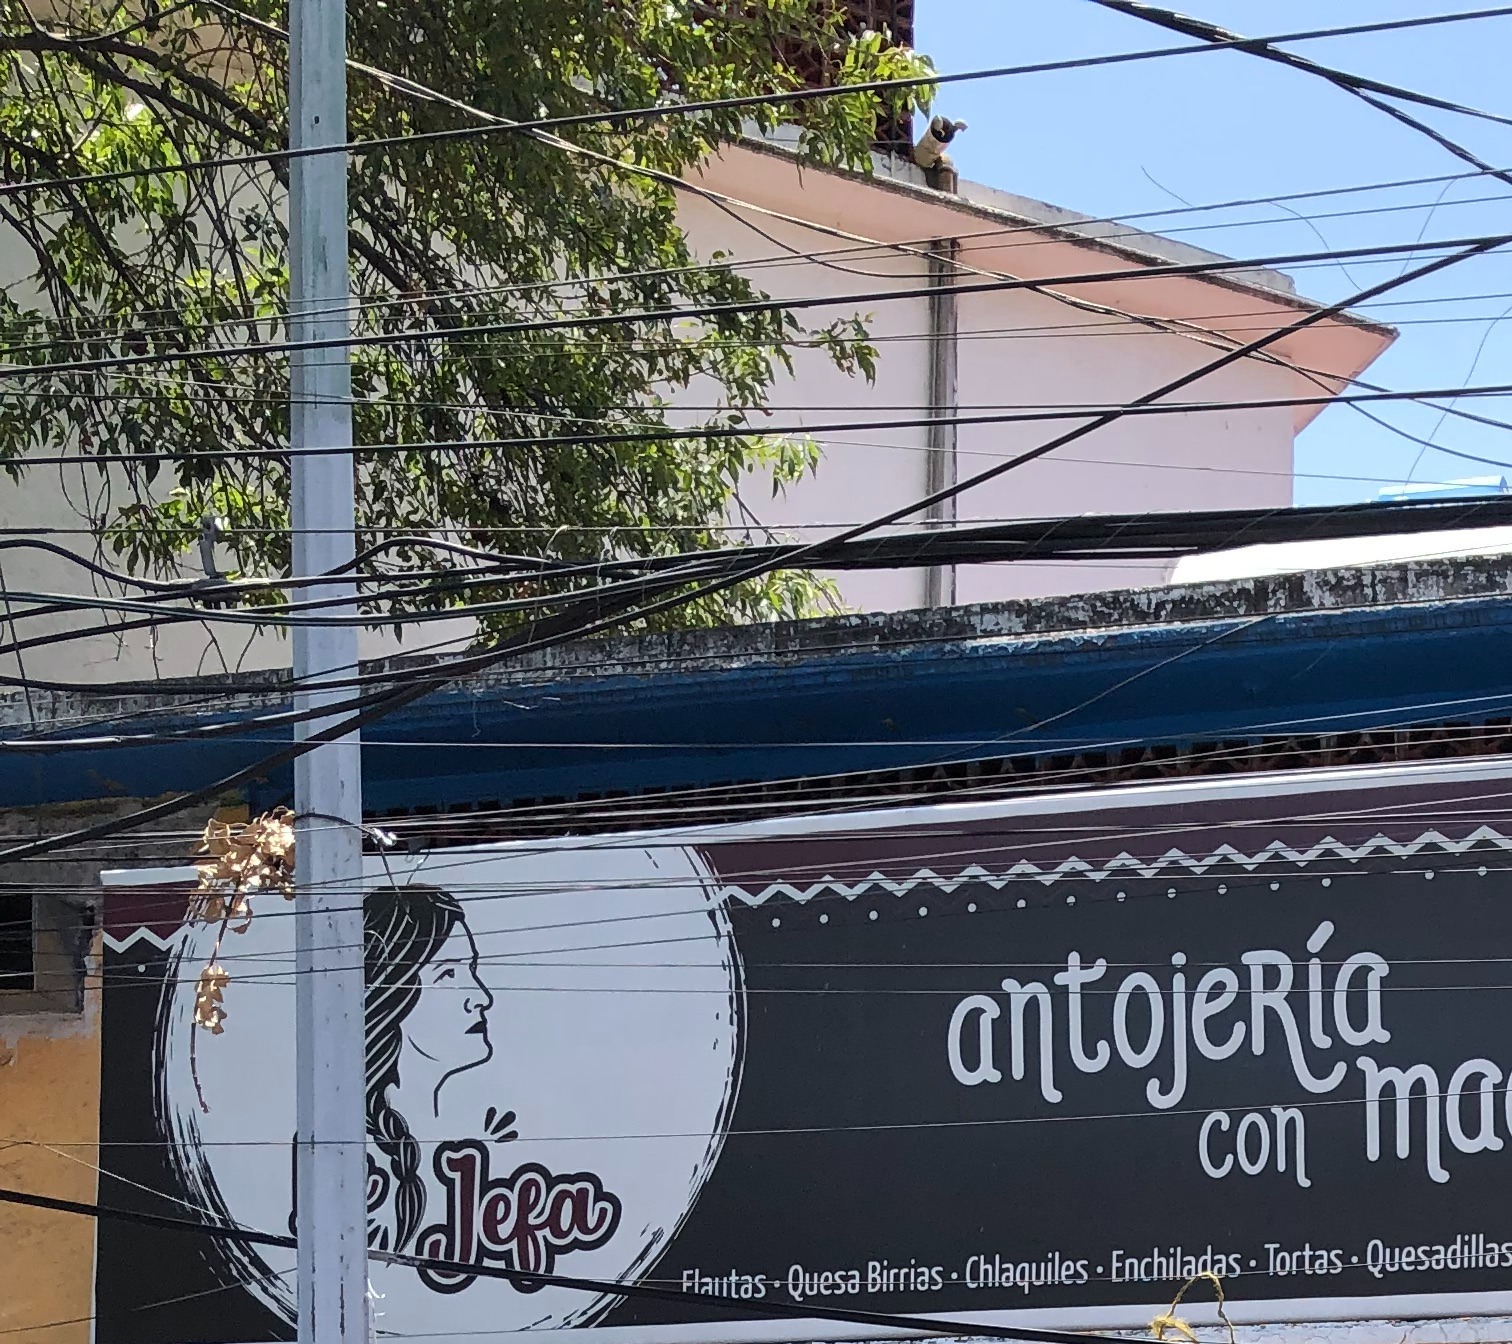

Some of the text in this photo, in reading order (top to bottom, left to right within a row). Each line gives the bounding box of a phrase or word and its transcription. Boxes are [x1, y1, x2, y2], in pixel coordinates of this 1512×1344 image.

[1199, 1105, 1311, 1188] con
[419, 1145, 617, 1288] Jefa
[682, 1268, 767, 1299] Flautas
[787, 1264, 860, 1301] Quesa
[867, 1258, 944, 1294] Birrias
[965, 1251, 1089, 1294] Chlaquiles
[1111, 1244, 1242, 1283] Enchiladas
[1264, 1242, 1343, 1276] Tortas
